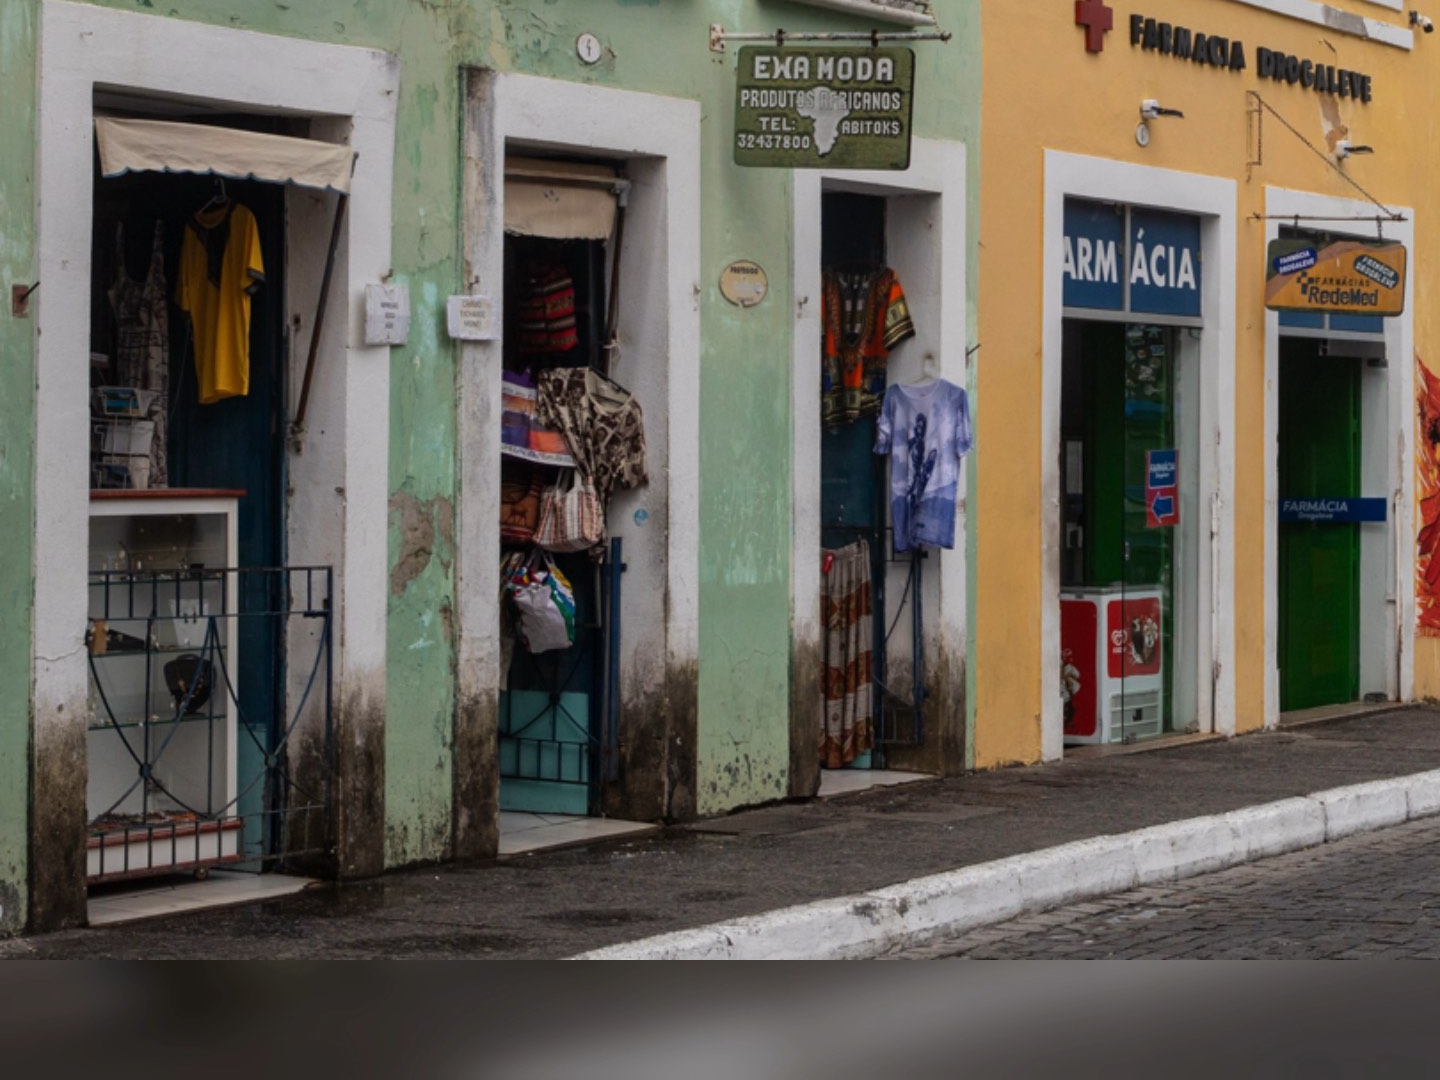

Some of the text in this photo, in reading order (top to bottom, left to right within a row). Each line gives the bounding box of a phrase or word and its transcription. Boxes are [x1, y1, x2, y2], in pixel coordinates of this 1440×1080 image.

[817, 56, 893, 81] MODA
[1256, 47, 1372, 103] DROGALEVE
[741, 89, 901, 111] PRODUTOS AFRICANOS
[759, 117, 796, 131] TEL:
[737, 134, 810, 149] 32437800
[1063, 228, 1196, 290] ARMÁCIA
[1315, 276, 1370, 287] FARMÁCIAS
[1308, 286, 1379, 306] RedeMed
[1283, 499, 1348, 512] FARMÁCIA
